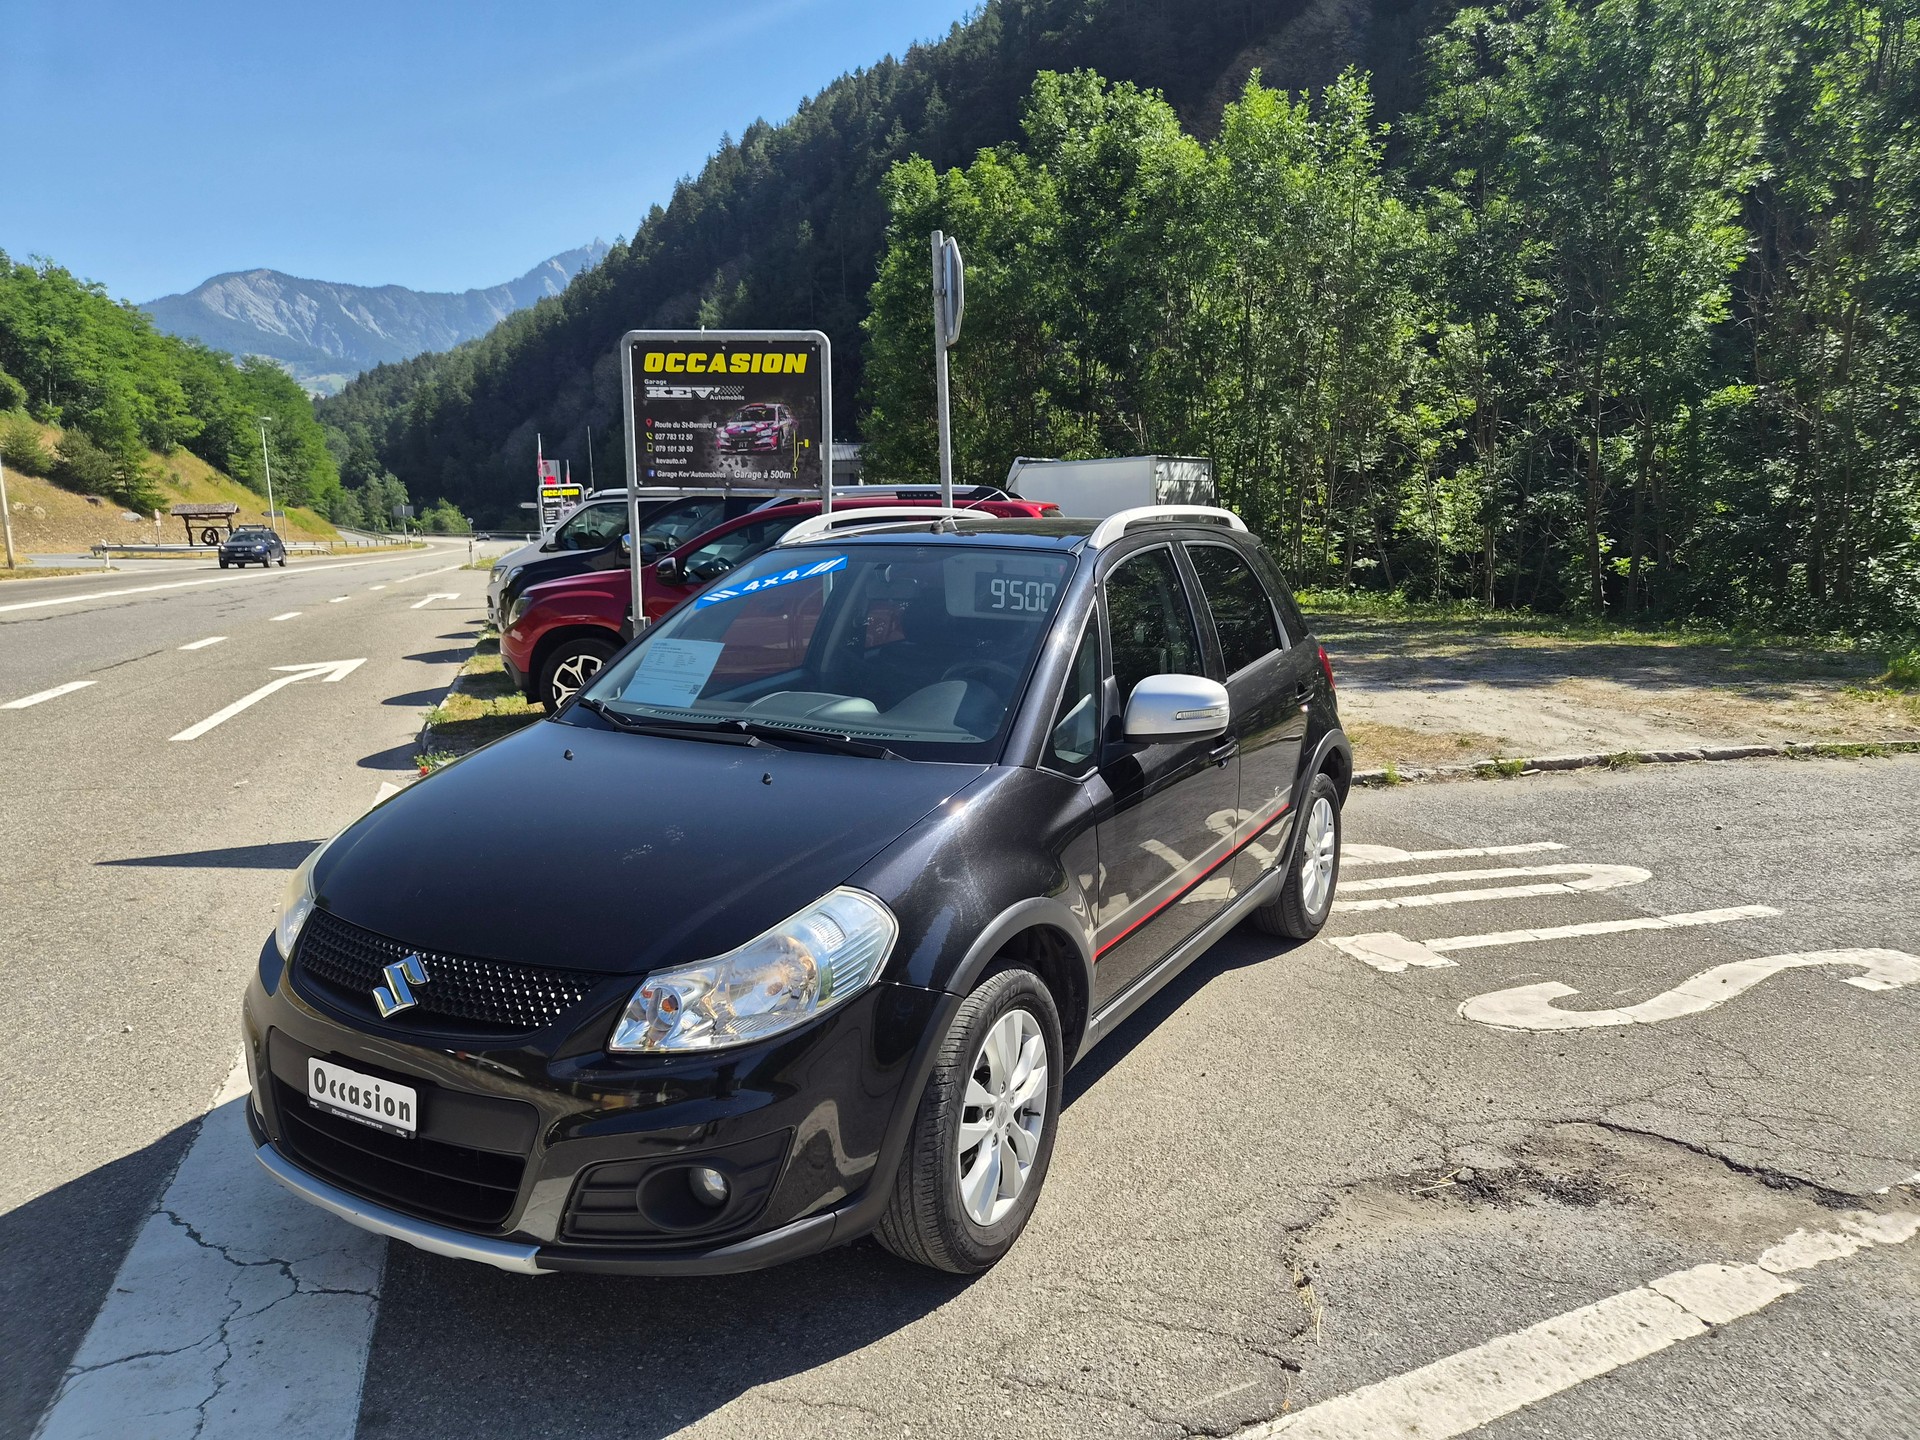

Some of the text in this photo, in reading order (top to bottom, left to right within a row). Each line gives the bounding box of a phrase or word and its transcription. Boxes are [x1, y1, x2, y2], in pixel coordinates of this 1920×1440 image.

[643, 352, 808, 374] OCCASION
[657, 470, 678, 479] Garage
[734, 469, 792, 480] Garage à 500m
[742, 569, 800, 592] 4x4
[313, 1067, 411, 1123] Occasion
